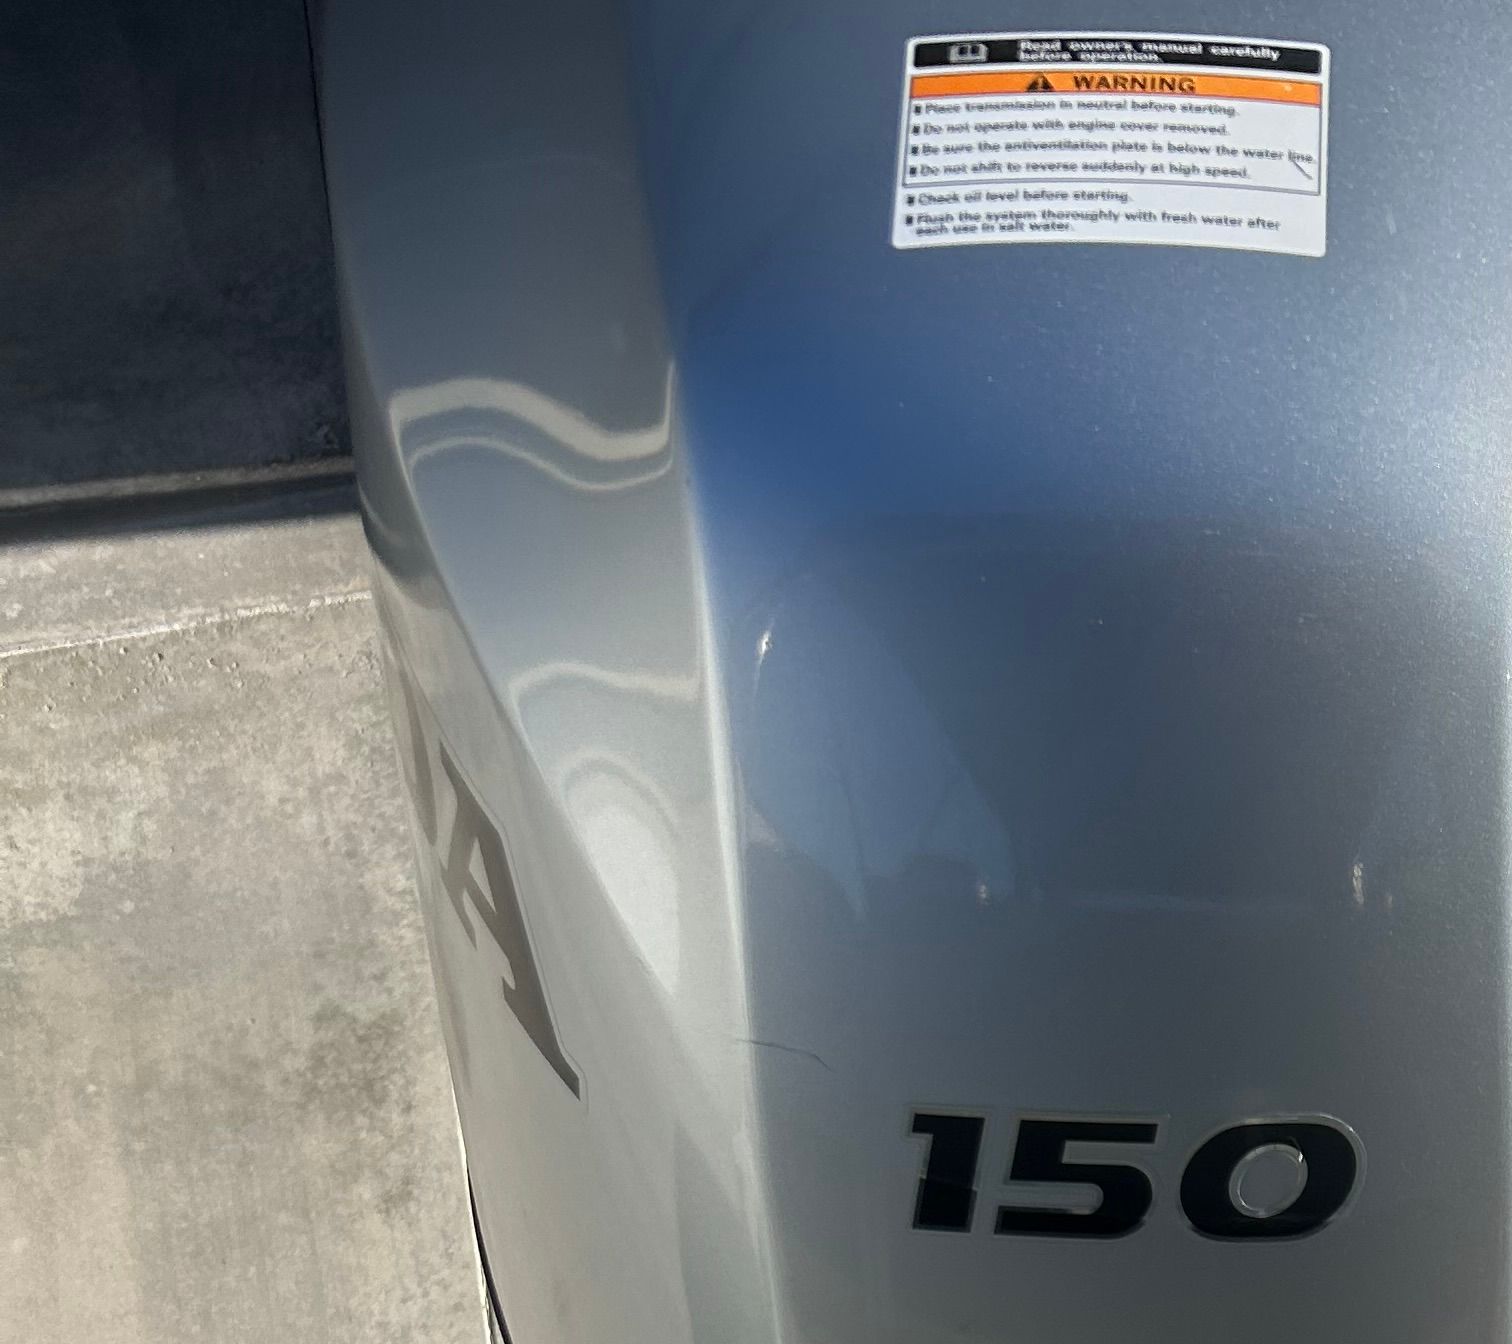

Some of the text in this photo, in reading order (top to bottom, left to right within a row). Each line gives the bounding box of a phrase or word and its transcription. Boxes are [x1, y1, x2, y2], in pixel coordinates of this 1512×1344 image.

[1142, 42, 1202, 54] manual
[1210, 44, 1280, 61] carefully
[1073, 75, 1195, 93] WARNING
[1060, 100, 1072, 109] in
[1078, 100, 1127, 110] neutral
[1132, 99, 1177, 111] before
[923, 125, 942, 135] Do
[947, 123, 969, 133] not
[974, 122, 1027, 134] operate
[1032, 120, 1063, 131] with
[1068, 121, 1115, 134] engine
[1121, 122, 1158, 131] cover
[978, 142, 1000, 152] the
[1112, 142, 1147, 154] plate
[1152, 142, 1163, 151] is
[1167, 142, 1210, 154] below
[1216, 145, 1238, 155] the
[1243, 148, 1284, 159] water
[920, 165, 939, 176] Do
[943, 164, 966, 173] not
[972, 162, 1001, 172] shift
[1007, 163, 1020, 172] to
[1026, 163, 1077, 171] reverse
[1151, 163, 1164, 173] at
[1169, 162, 1200, 176] high
[918, 193, 959, 204] Check
[964, 191, 981, 201] oil
[986, 190, 1018, 201] level
[1023, 190, 1068, 200] before
[953, 224, 978, 233] use
[982, 222, 994, 231] in
[999, 221, 1023, 230] salt
[958, 212, 981, 221] the
[985, 211, 1036, 223] system
[1042, 210, 1119, 223] thoroughly
[1124, 210, 1157, 222] with
[1161, 210, 1196, 223] fresh
[1201, 214, 1243, 227] water
[1247, 216, 1281, 230] after
[909, 1107, 1366, 1242] 150
